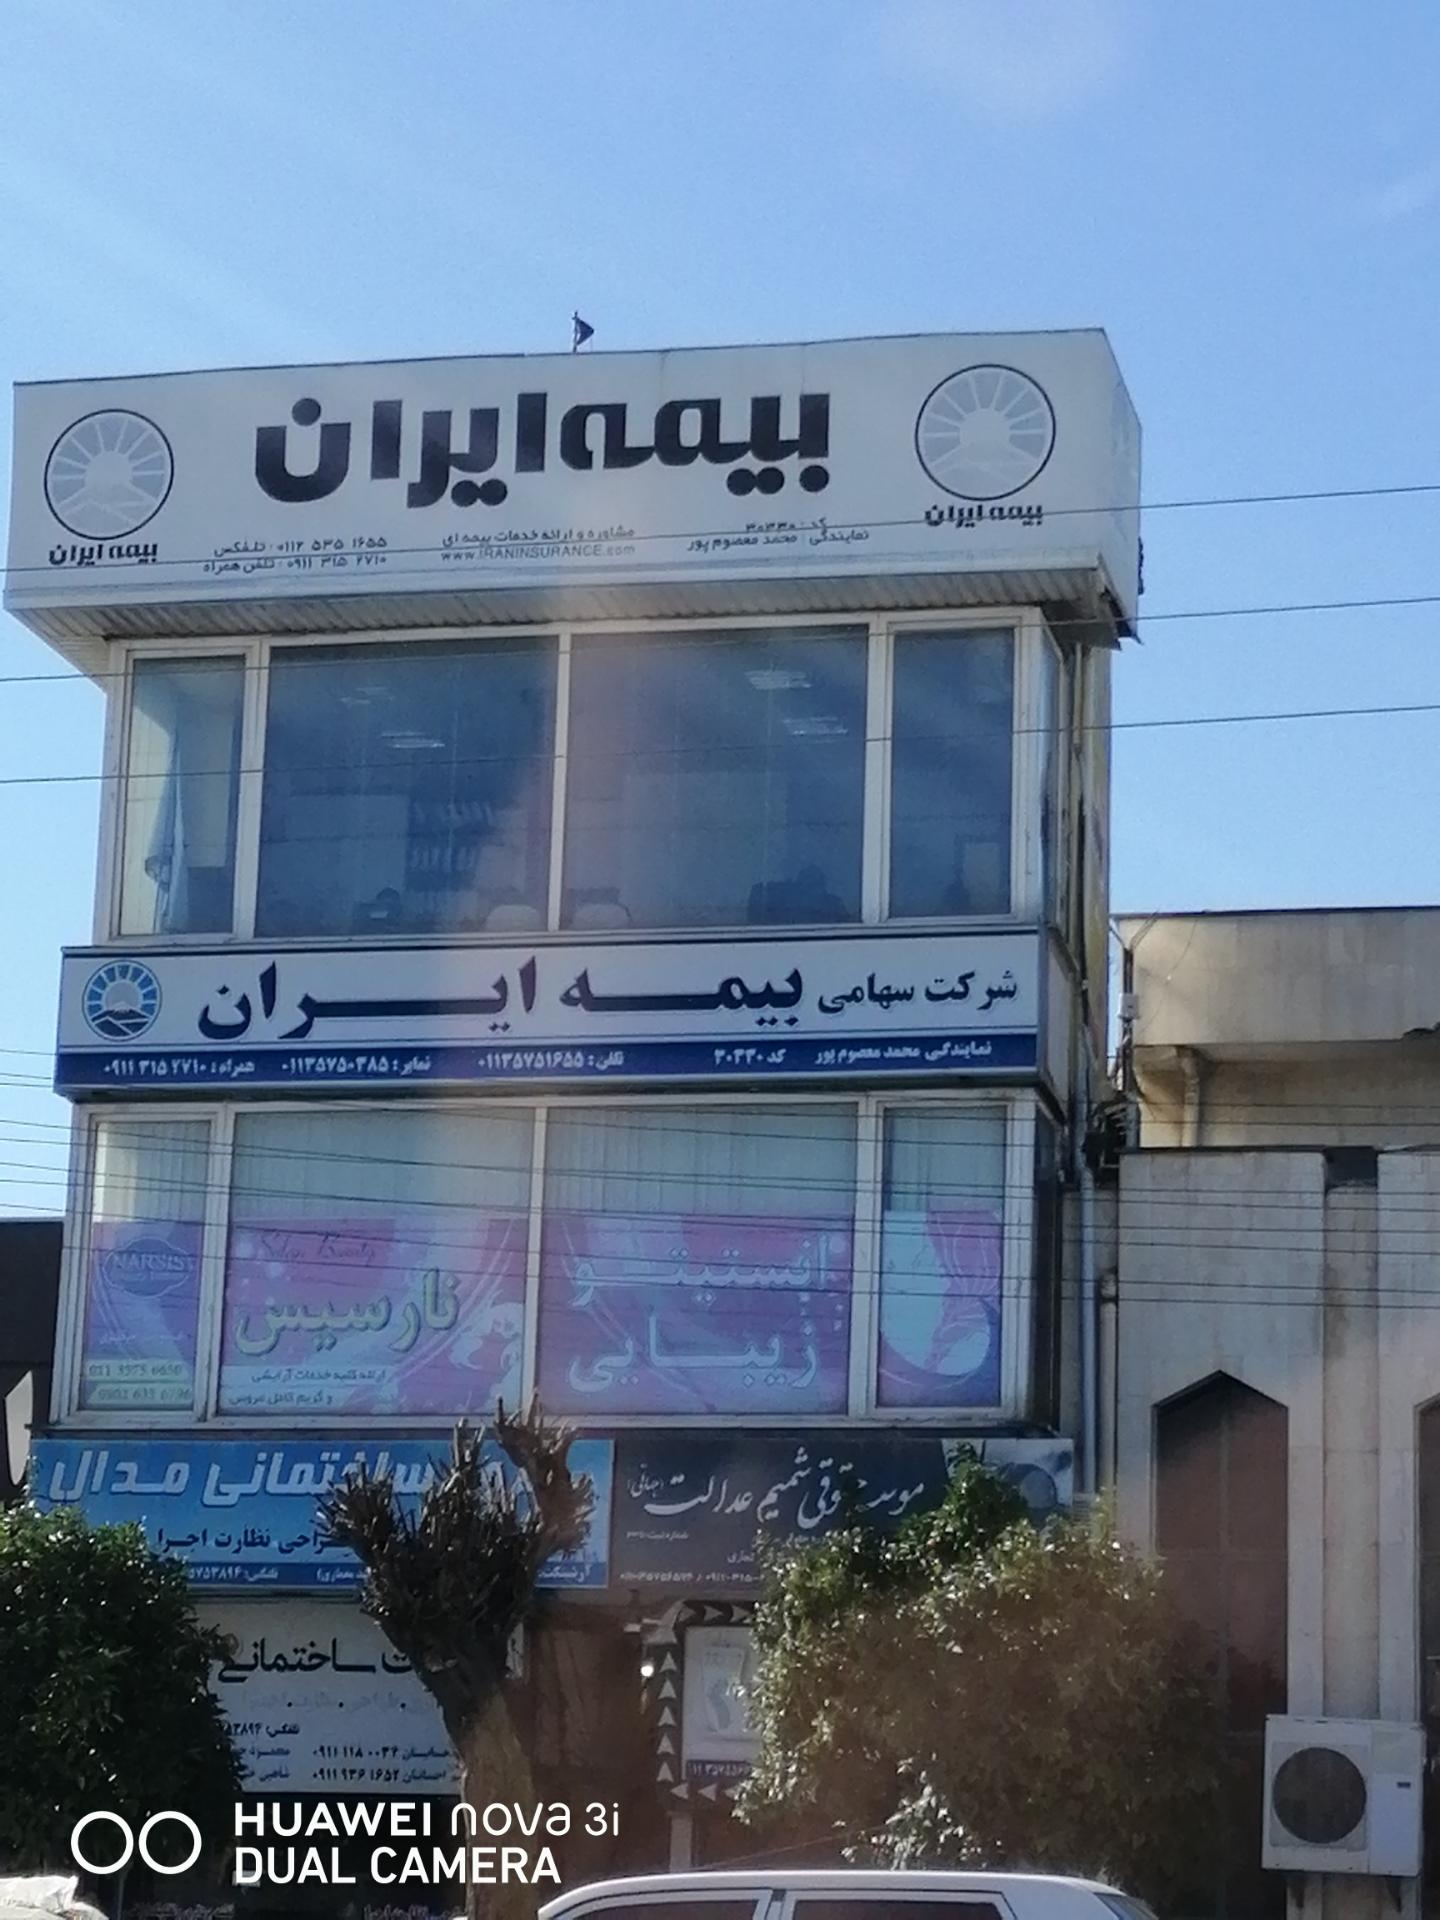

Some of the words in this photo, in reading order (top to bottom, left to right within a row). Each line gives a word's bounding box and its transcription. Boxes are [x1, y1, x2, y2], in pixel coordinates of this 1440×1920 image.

[255, 391, 548, 510] ایران
[560, 392, 830, 497] بیمه
[925, 503, 983, 530] ایران
[987, 504, 1043, 528] بیمه
[461, 534, 492, 547] بیمه
[494, 530, 538, 543] خدمات
[587, 525, 635, 539] مشاوره
[763, 534, 797, 546] محمد
[809, 529, 870, 546] نمایندگی
[48, 543, 105, 567] ایران
[109, 543, 159, 563] بیمه
[202, 560, 240, 575] همراه
[198, 954, 537, 1040] ایران
[559, 966, 803, 1028] بیمه
[817, 973, 915, 1014] سهامی
[923, 969, 1017, 1012] شرکت
[767, 1047, 787, 1063] کد
[883, 1047, 921, 1059] محمد
[925, 1040, 993, 1061] نمایندگی
[569, 1234, 828, 1307] انستیتو
[233, 1266, 461, 1358] نارسیس
[568, 1305, 818, 1393] زیبایی
[295, 1368, 331, 1381] خدمات
[49, 1449, 190, 1502] مدال
[643, 1472, 754, 1515] عدالت
[158, 1527, 206, 1554] اجرا
[214, 1525, 270, 1554] نظارت
[277, 1529, 357, 1555] راحی
[218, 1637, 376, 1683] ساختمانی
